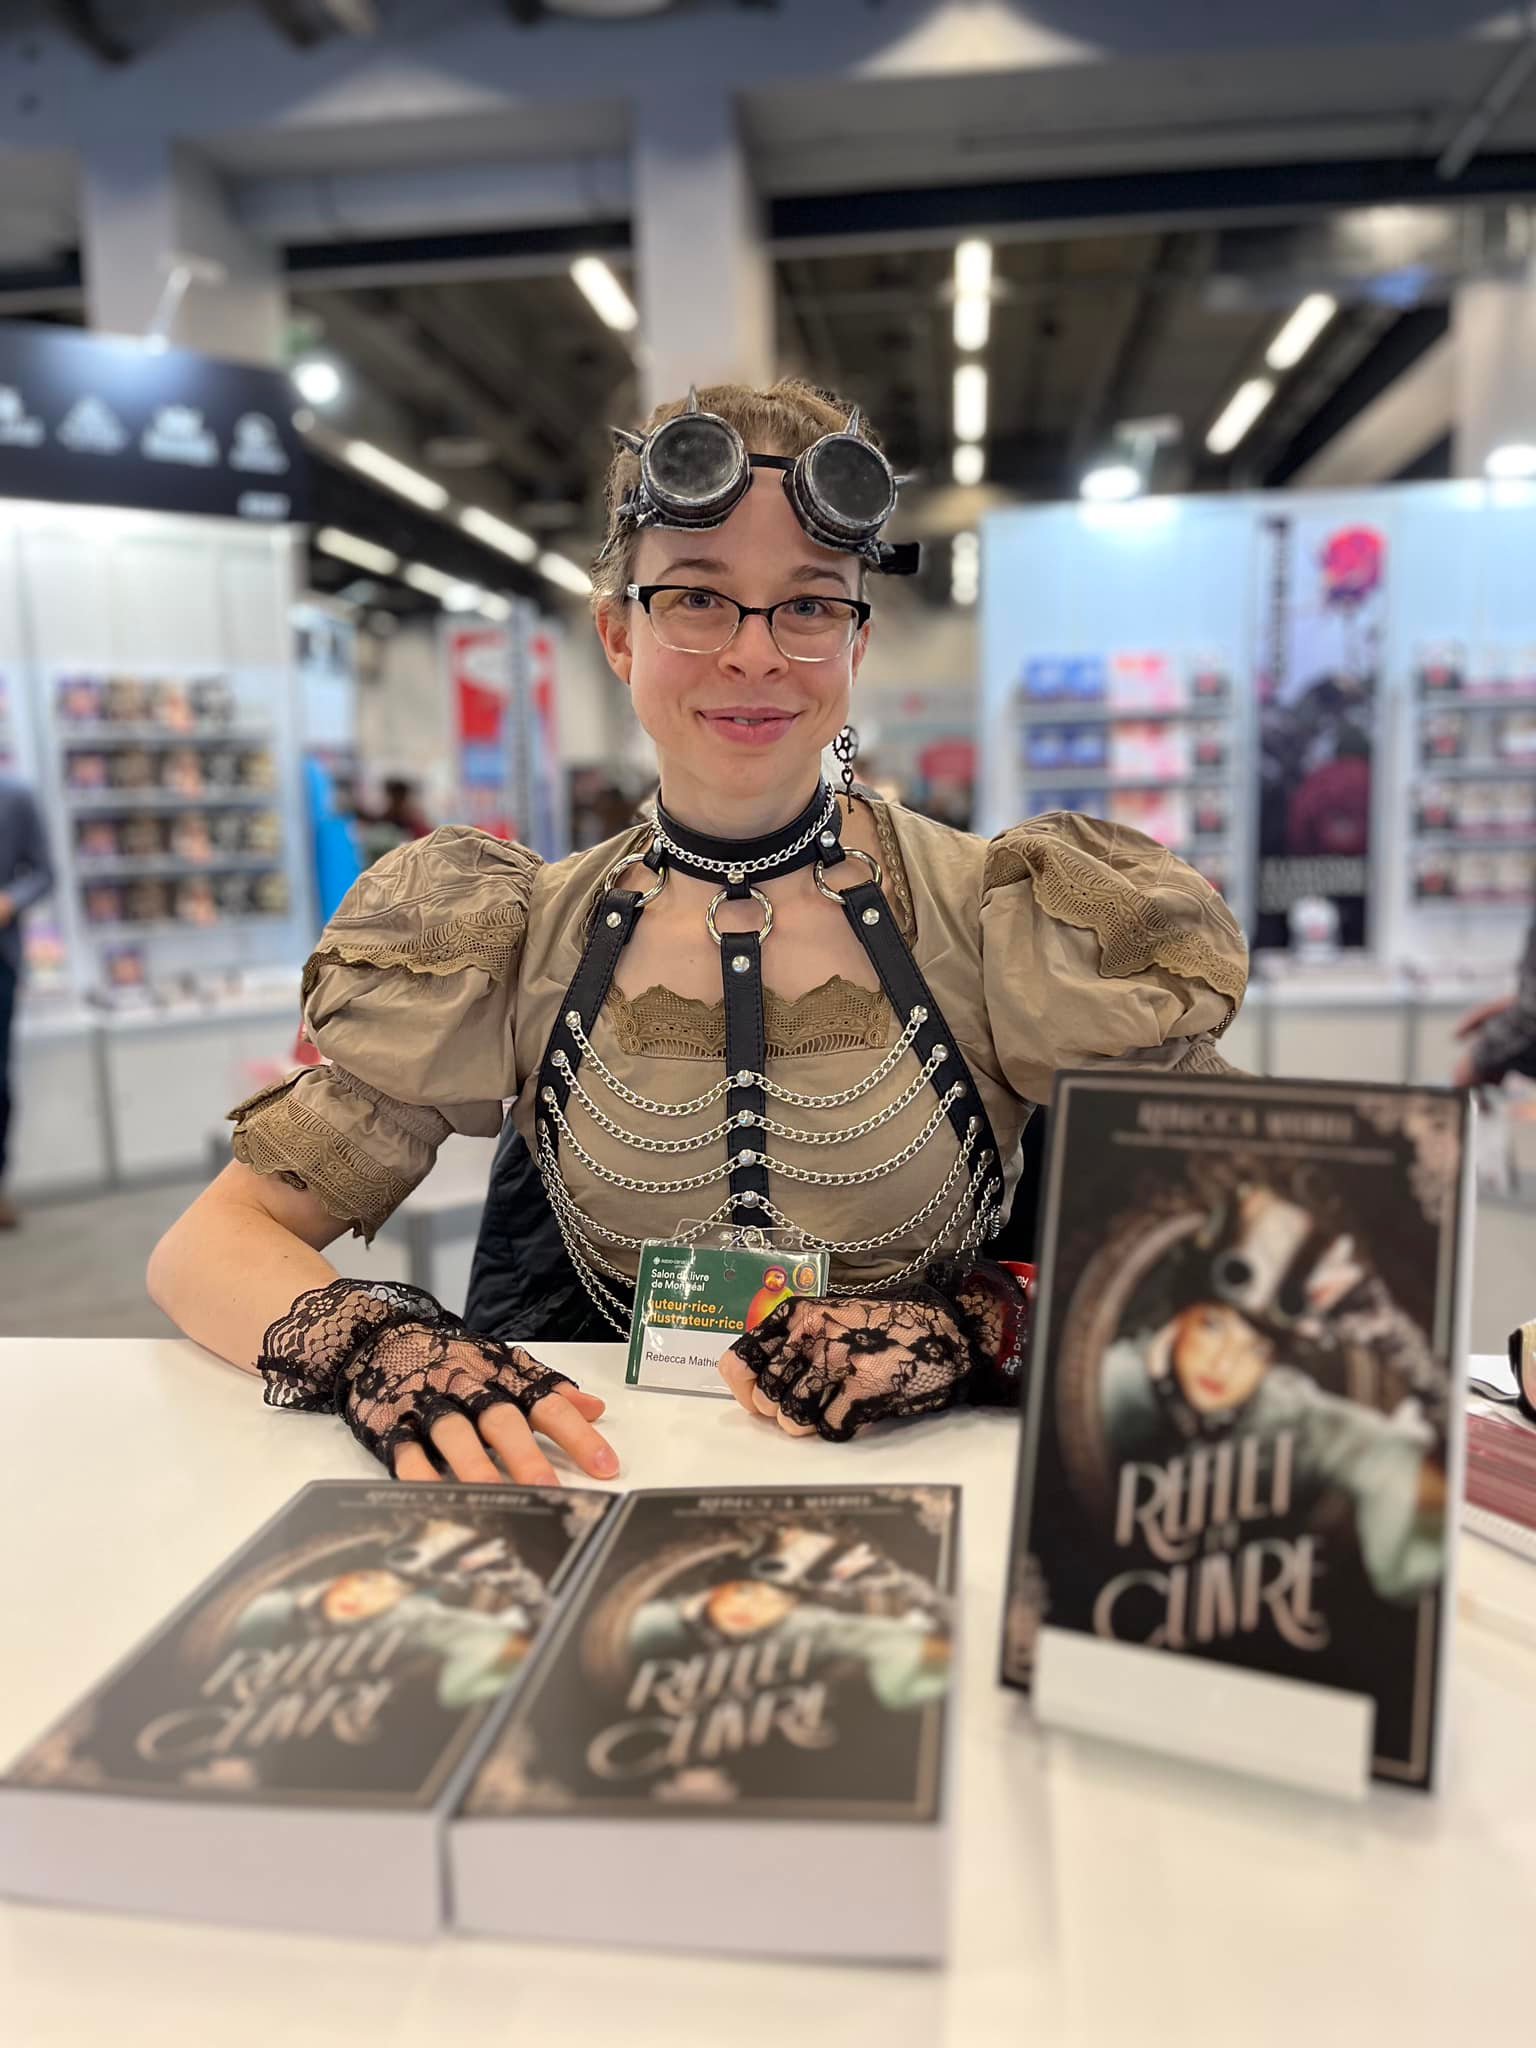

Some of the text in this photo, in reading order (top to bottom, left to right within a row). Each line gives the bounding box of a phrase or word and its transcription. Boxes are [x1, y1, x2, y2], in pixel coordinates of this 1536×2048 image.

[651, 1268, 675, 1279] Salon
[690, 1271, 710, 1282] livre
[651, 1279, 663, 1288] de
[646, 1351, 686, 1364] Rebecca
